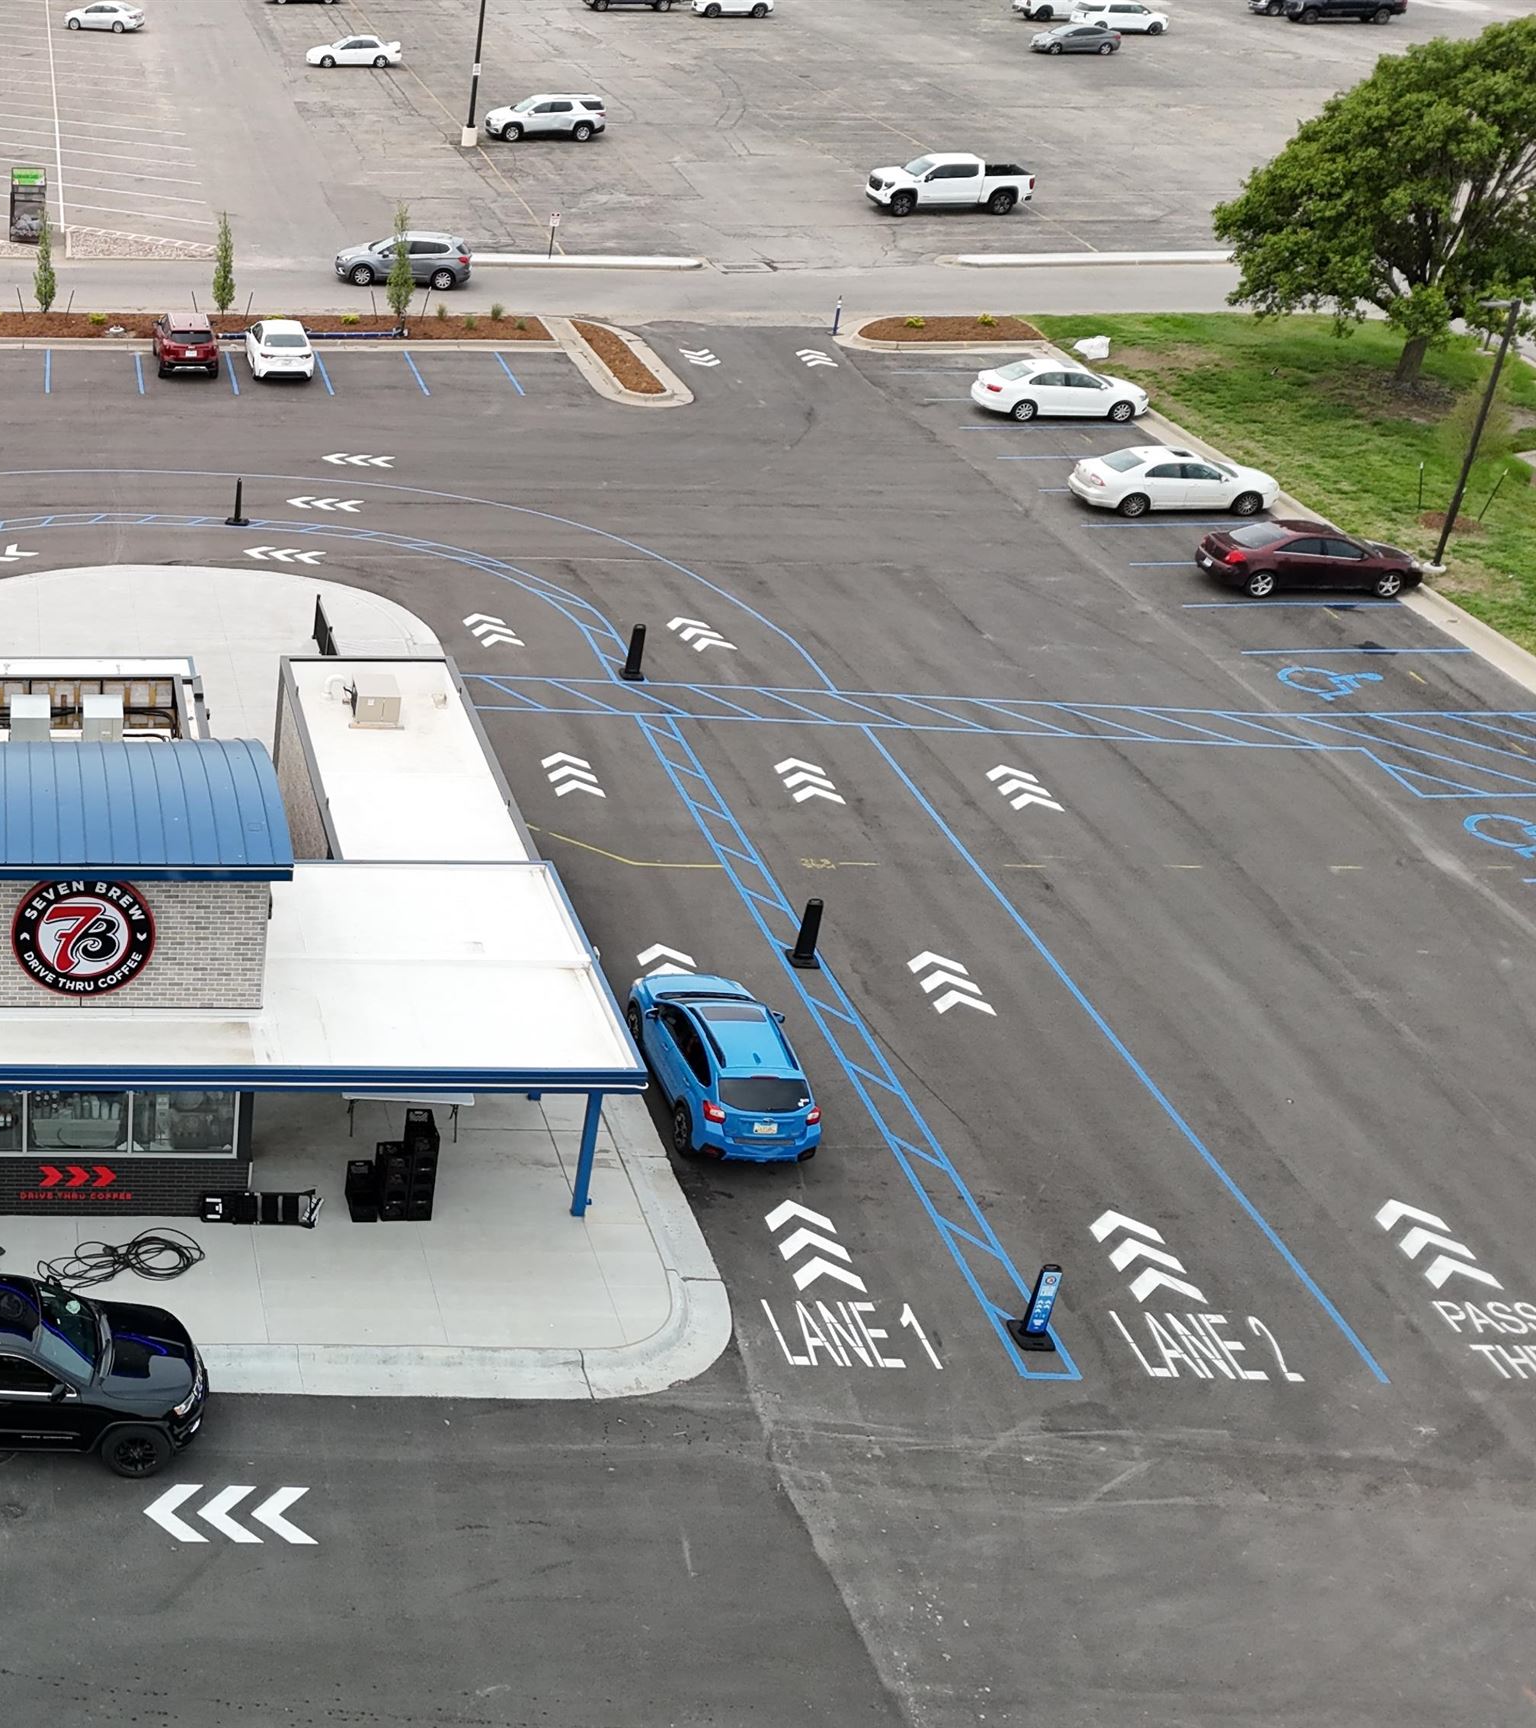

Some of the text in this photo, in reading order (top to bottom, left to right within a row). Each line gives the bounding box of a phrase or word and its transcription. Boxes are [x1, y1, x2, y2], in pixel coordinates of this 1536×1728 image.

[24, 881, 146, 921] SEVEN BREW
[24, 951, 143, 991] DRIVE THRU COFFEE
[19, 1191, 132, 1200] DRIVE THRU COFFEE
[760, 1299, 943, 1370] LANE 1
[1108, 1310, 1306, 1382] LANE 2
